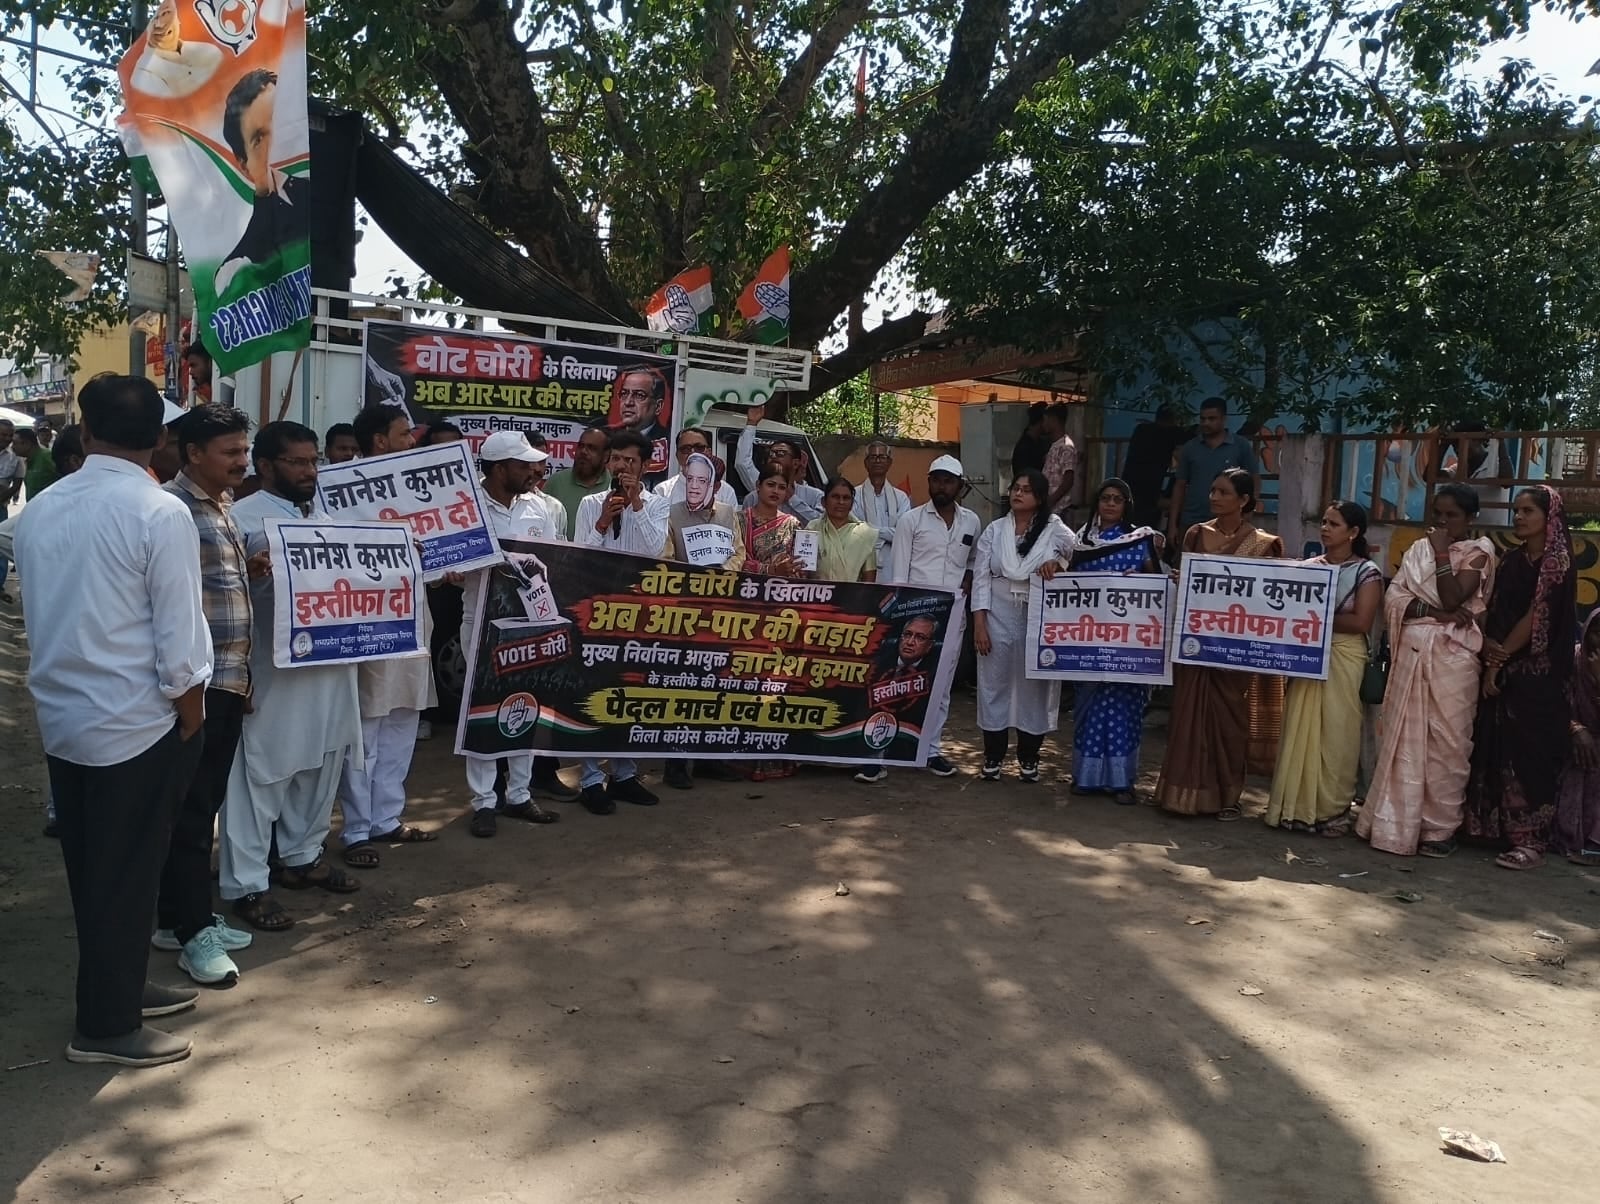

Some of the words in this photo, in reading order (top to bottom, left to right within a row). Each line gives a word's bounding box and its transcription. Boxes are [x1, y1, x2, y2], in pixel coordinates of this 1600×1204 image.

[415, 336, 469, 374] वोट
[474, 343, 533, 378] चोरी
[543, 355, 559, 378] के
[561, 356, 618, 381] खिलाफ
[413, 380, 453, 403] अब
[456, 382, 533, 407] आर-पार
[535, 381, 563, 408] की
[565, 384, 613, 415] लड़ाई
[460, 418, 485, 432] मुख्य
[489, 416, 532, 434] निर्वाचन
[536, 421, 572, 437] आयुक्त
[323, 469, 397, 511] ज्ञानेश
[400, 459, 468, 502] कुमार
[444, 490, 478, 529] दो
[685, 528, 712, 543] ज्ञानेश
[689, 547, 712, 560] चुनाव
[287, 530, 352, 571] ज्ञानेश
[354, 543, 409, 581] कुमार
[295, 578, 385, 625] इस्तीफा
[389, 576, 412, 618] दो
[526, 585, 547, 602] VOTE
[640, 563, 686, 594] वोट
[689, 569, 739, 597] चोरी
[740, 577, 760, 599] के
[764, 578, 836, 603] खिलाफ
[1045, 580, 1101, 609] ज्ञानेश
[1106, 588, 1164, 617] कुमार
[1191, 565, 1256, 598] ज्ञानेश
[1262, 578, 1327, 611] कुमार
[588, 601, 641, 632] अब
[644, 605, 760, 641] आर-पार
[762, 608, 802, 643] की
[803, 617, 876, 655] लड़ाई
[1043, 614, 1130, 644] इस्तीफा
[1135, 615, 1163, 647] दो
[1188, 603, 1287, 639] इस्तीफा
[1291, 610, 1322, 644] दो
[498, 644, 537, 666] VOTE
[540, 634, 566, 656] चोरी
[582, 643, 620, 667] मुख्य
[623, 640, 682, 665] निर्वाचन
[684, 649, 729, 671] आयुक्त
[730, 646, 807, 677] ज्ञानेश
[809, 658, 869, 688] कुमार
[648, 670, 660, 685] के
[662, 672, 699, 688] इस्तीफे
[700, 674, 716, 688] की
[719, 675, 741, 690] मांग
[743, 677, 759, 691] को
[761, 678, 788, 693] लेकर
[873, 681, 911, 703] इस्तीफा
[913, 675, 925, 692] दो
[606, 688, 669, 723] पैदल
[674, 691, 727, 720] मार्च
[730, 696, 763, 721] एवं
[768, 695, 828, 726] घेराव
[628, 725, 661, 744] जिला
[663, 726, 702, 745] कांग्रेस
[704, 726, 740, 745] कमेटी
[743, 731, 789, 750] अनूपपुर
